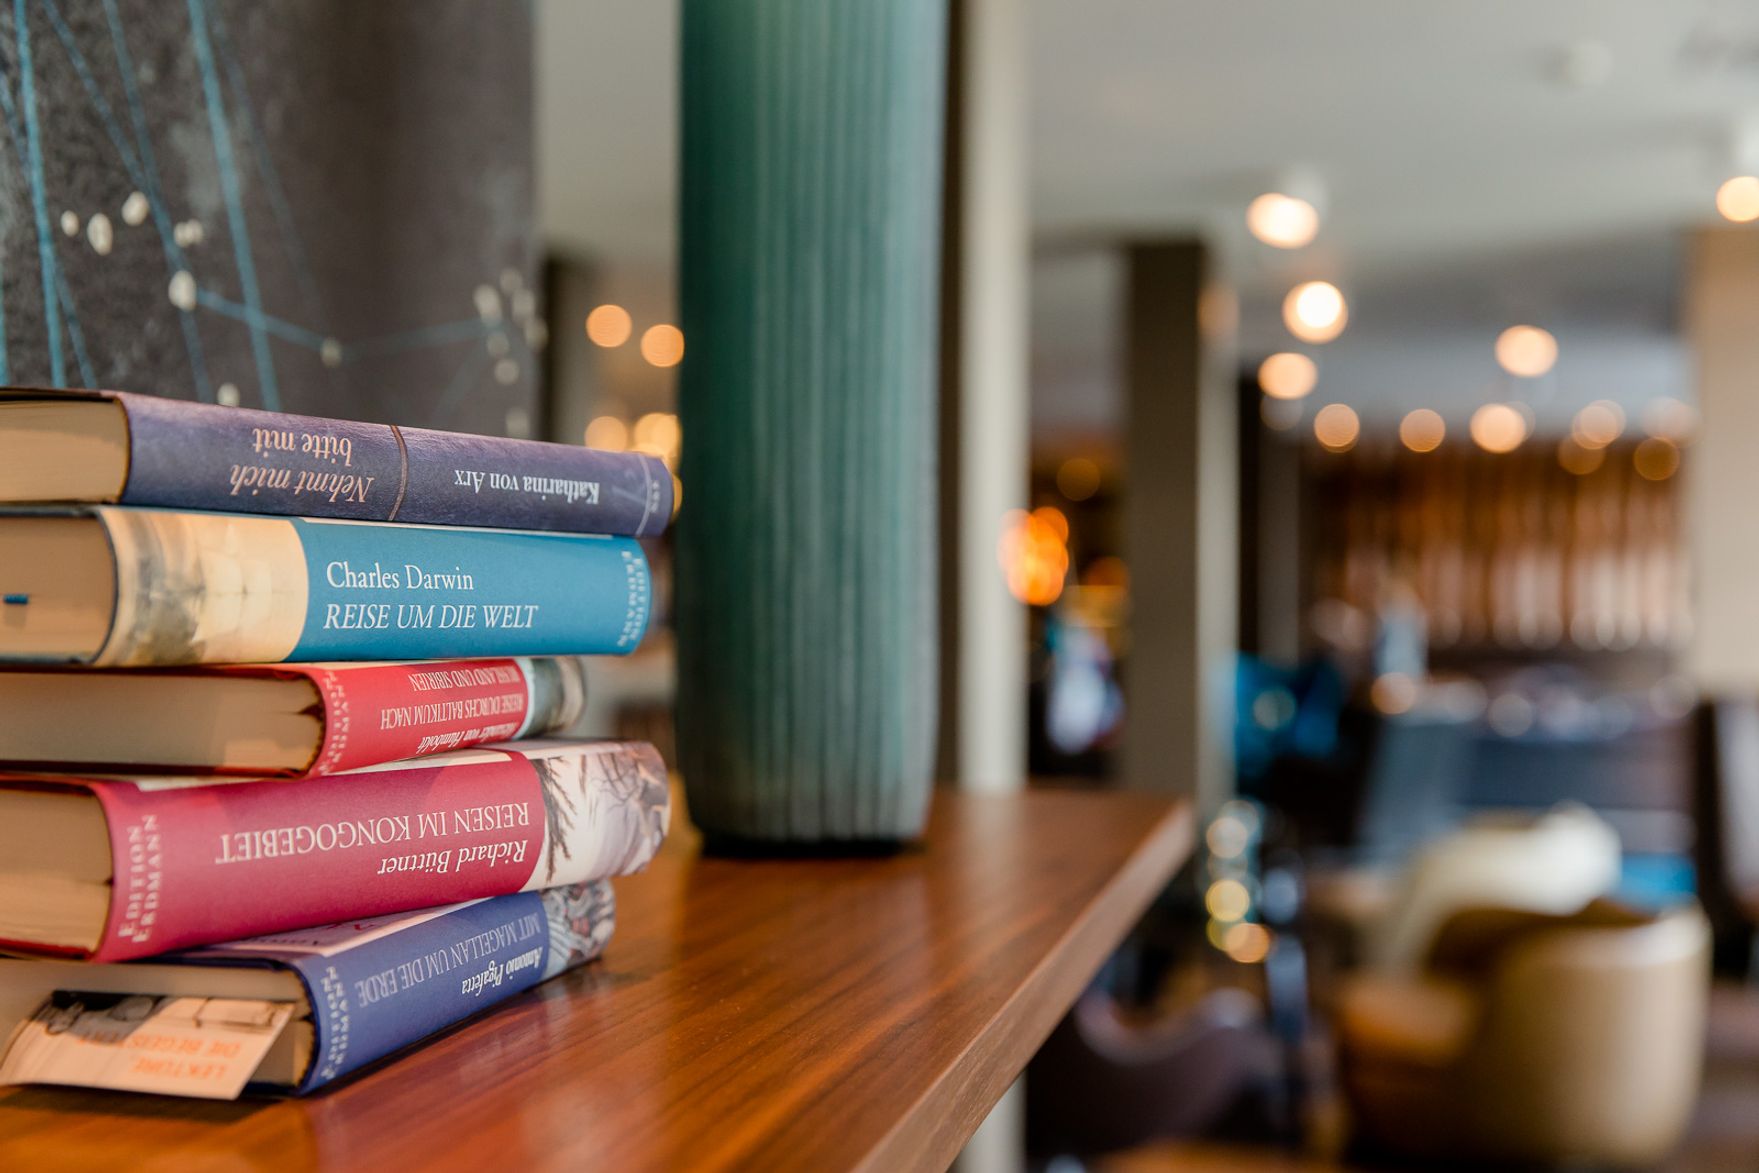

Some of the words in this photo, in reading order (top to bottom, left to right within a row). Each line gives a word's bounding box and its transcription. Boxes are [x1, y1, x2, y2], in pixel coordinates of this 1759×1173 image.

[252, 426, 296, 460] mit
[301, 432, 352, 467] bitte
[228, 463, 292, 497] mich
[293, 469, 375, 504] Nehmt
[453, 468, 486, 492] Arx
[489, 472, 520, 494] von
[522, 473, 601, 506] Katharina
[326, 561, 400, 590] Charles
[406, 564, 474, 592] Darwin
[323, 603, 390, 629] REISE
[396, 603, 437, 629] UM
[438, 604, 477, 629] DIE
[482, 604, 539, 629] WELT
[407, 671, 453, 692] SIBIRIEN
[450, 669, 475, 688] UND
[380, 707, 412, 731] NACH
[413, 701, 463, 726] BALTIKUM
[464, 696, 500, 719] DURCHS
[416, 731, 465, 754] Humboldt
[416, 811, 447, 839] IM
[453, 801, 529, 833] REISEN
[215, 814, 412, 865] KONGOGEBIET
[376, 848, 452, 877] Büttner
[453, 839, 528, 873] Richard
[118, 825, 145, 938] EDITION
[131, 815, 162, 943] ERDMANN
[517, 912, 541, 942] MIT
[449, 922, 517, 969] MAGELLAN
[396, 957, 422, 991] DIE
[424, 948, 450, 977] UM
[461, 959, 504, 997] Pigafetta
[505, 946, 543, 980] Antonio
[354, 969, 396, 1008] ERDE
